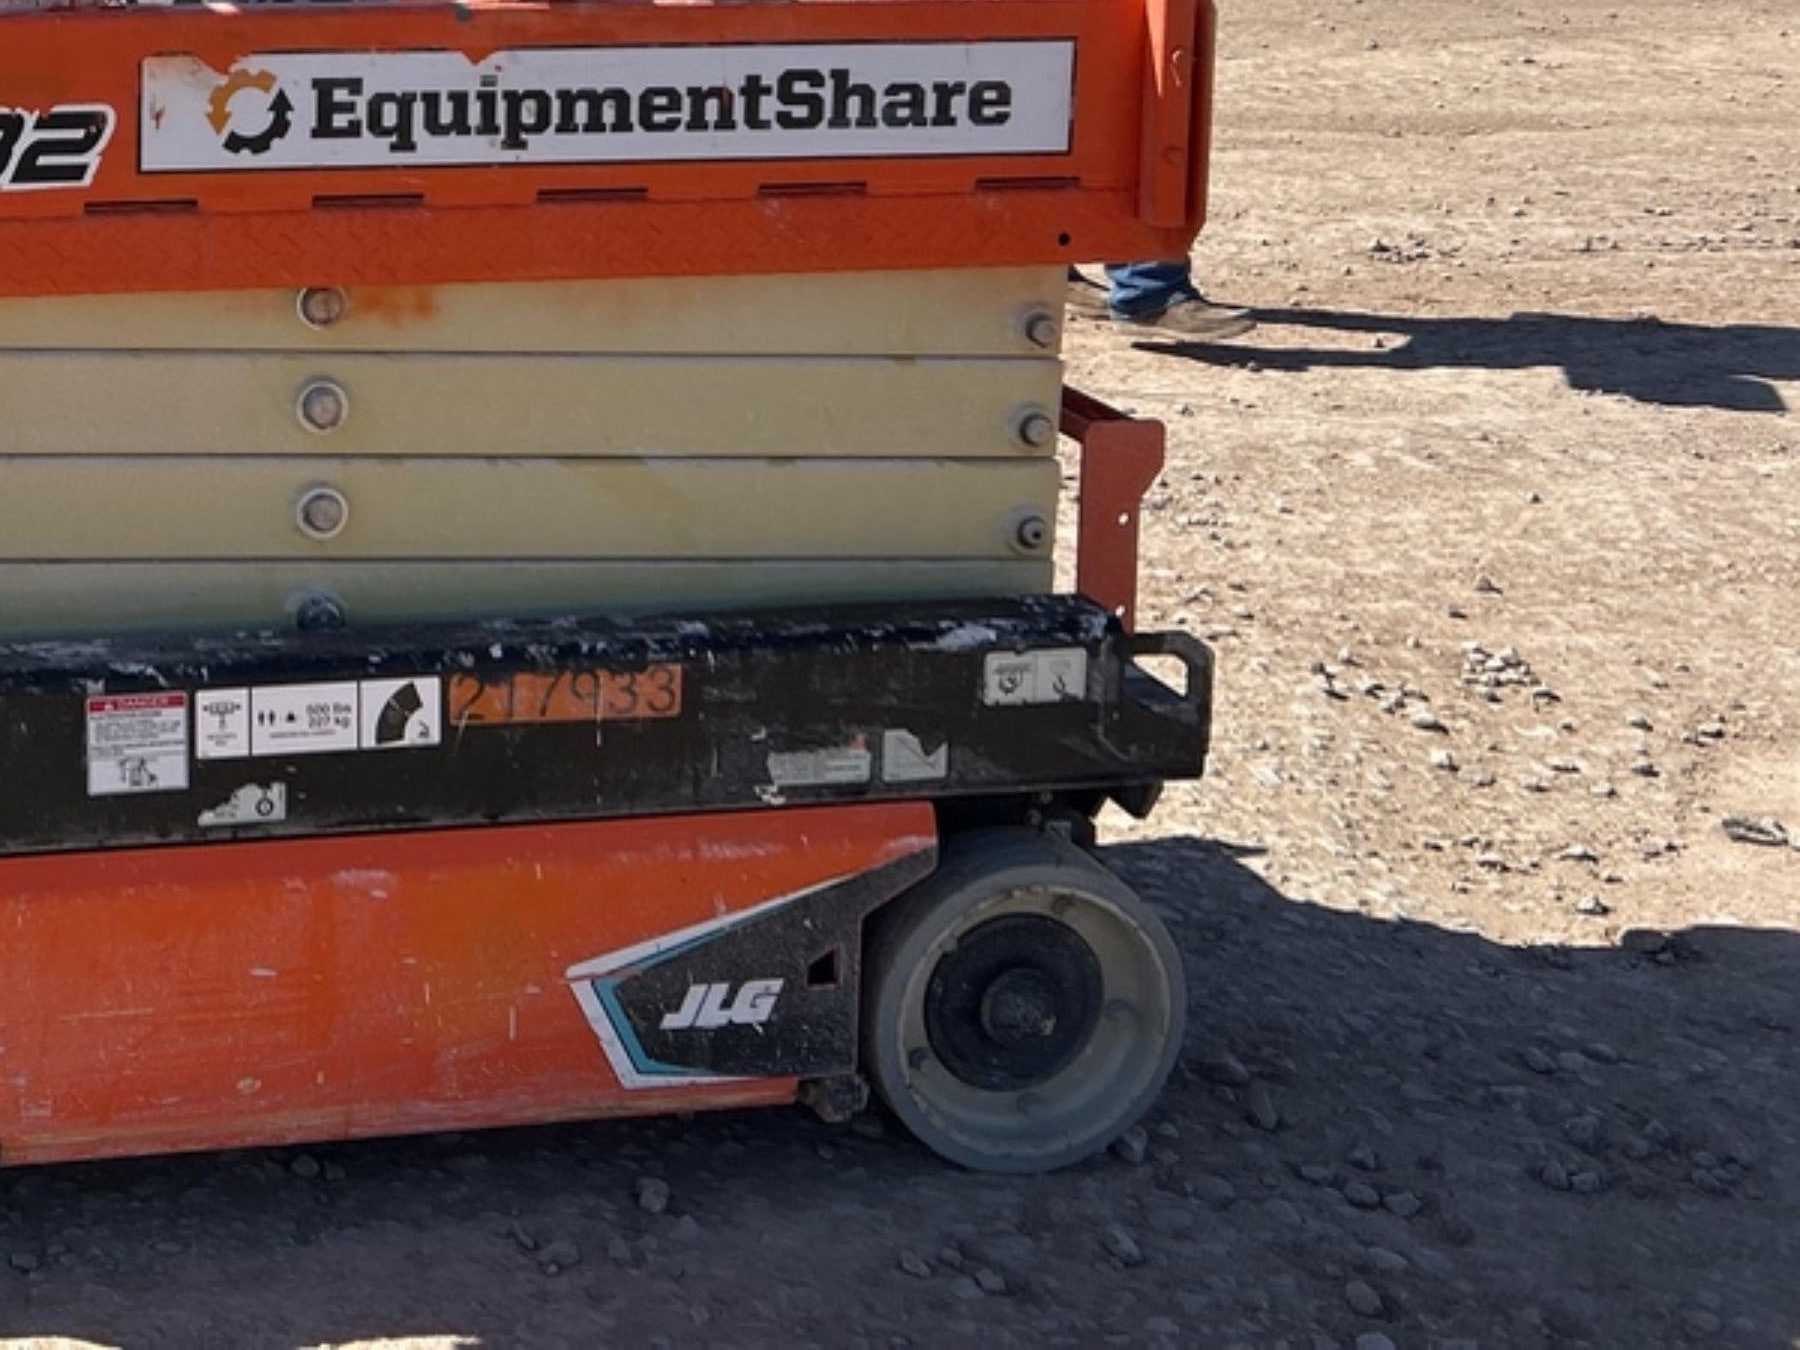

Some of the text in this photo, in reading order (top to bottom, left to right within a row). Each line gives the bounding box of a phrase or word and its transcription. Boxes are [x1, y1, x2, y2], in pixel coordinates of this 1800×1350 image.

[310, 67, 1012, 153] EquipmentShare
[453, 666, 678, 720] 217933
[658, 977, 785, 1030] JLG
